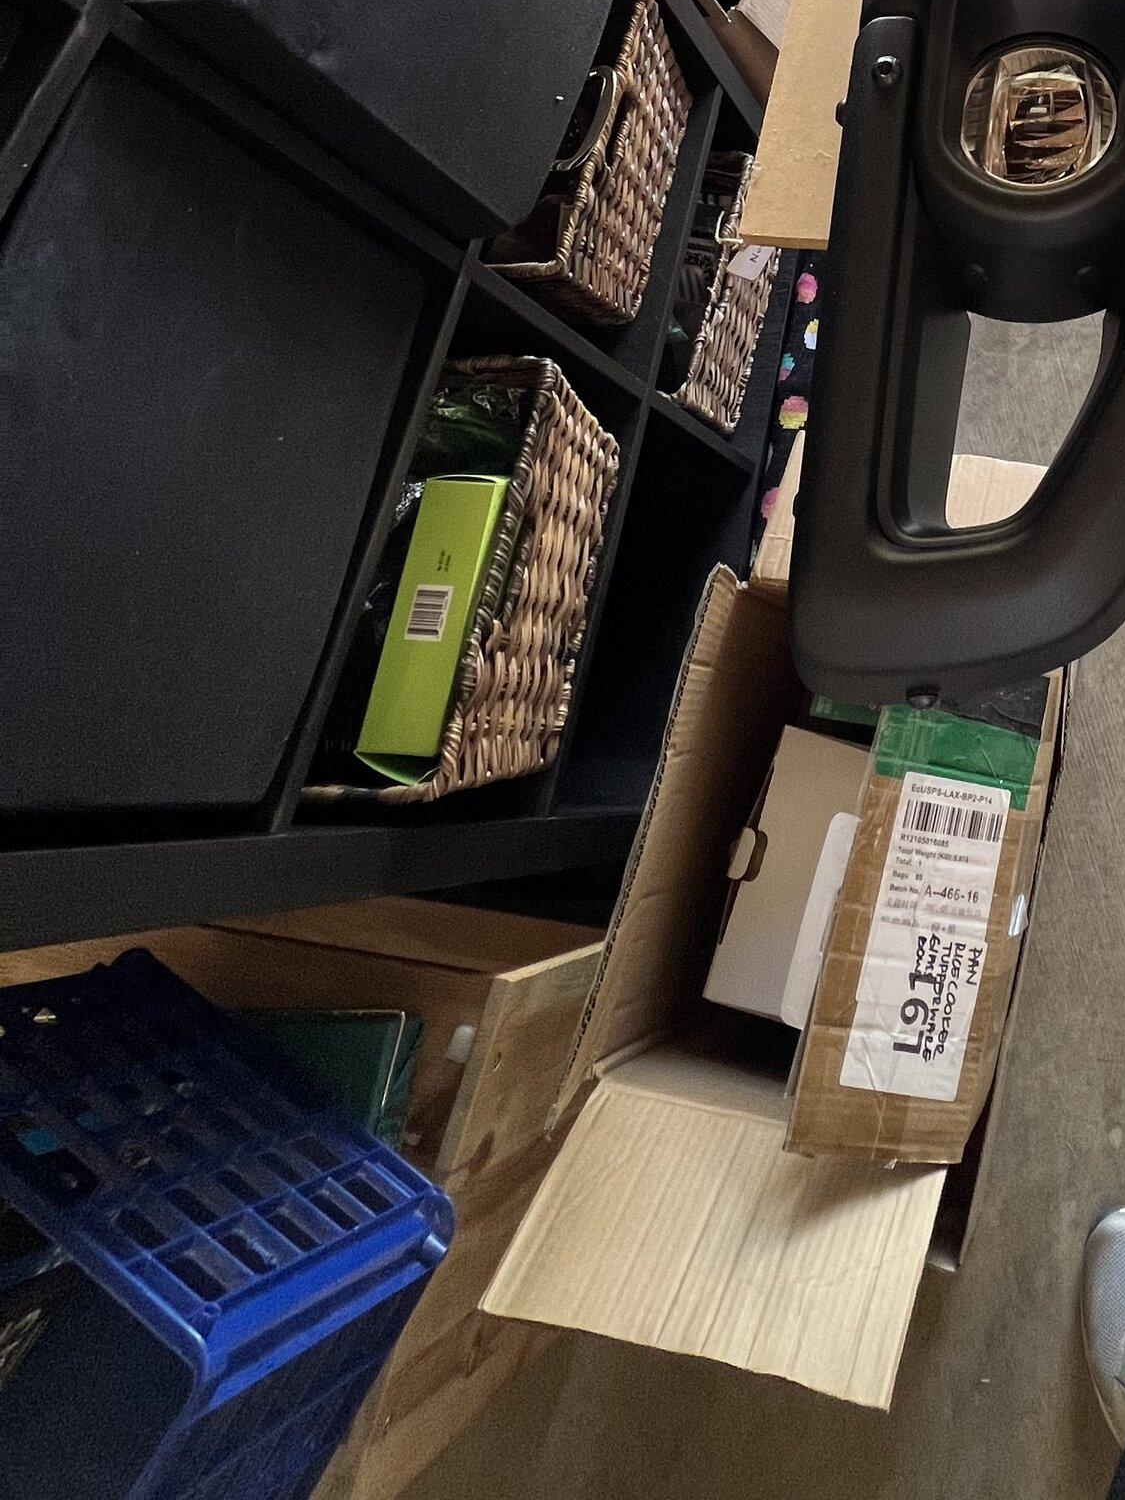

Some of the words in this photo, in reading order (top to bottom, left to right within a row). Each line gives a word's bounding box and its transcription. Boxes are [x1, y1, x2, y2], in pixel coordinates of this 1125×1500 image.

[950, 942, 966, 979] RICE
[966, 947, 983, 985] PAN
[932, 980, 958, 1060] COOKER
